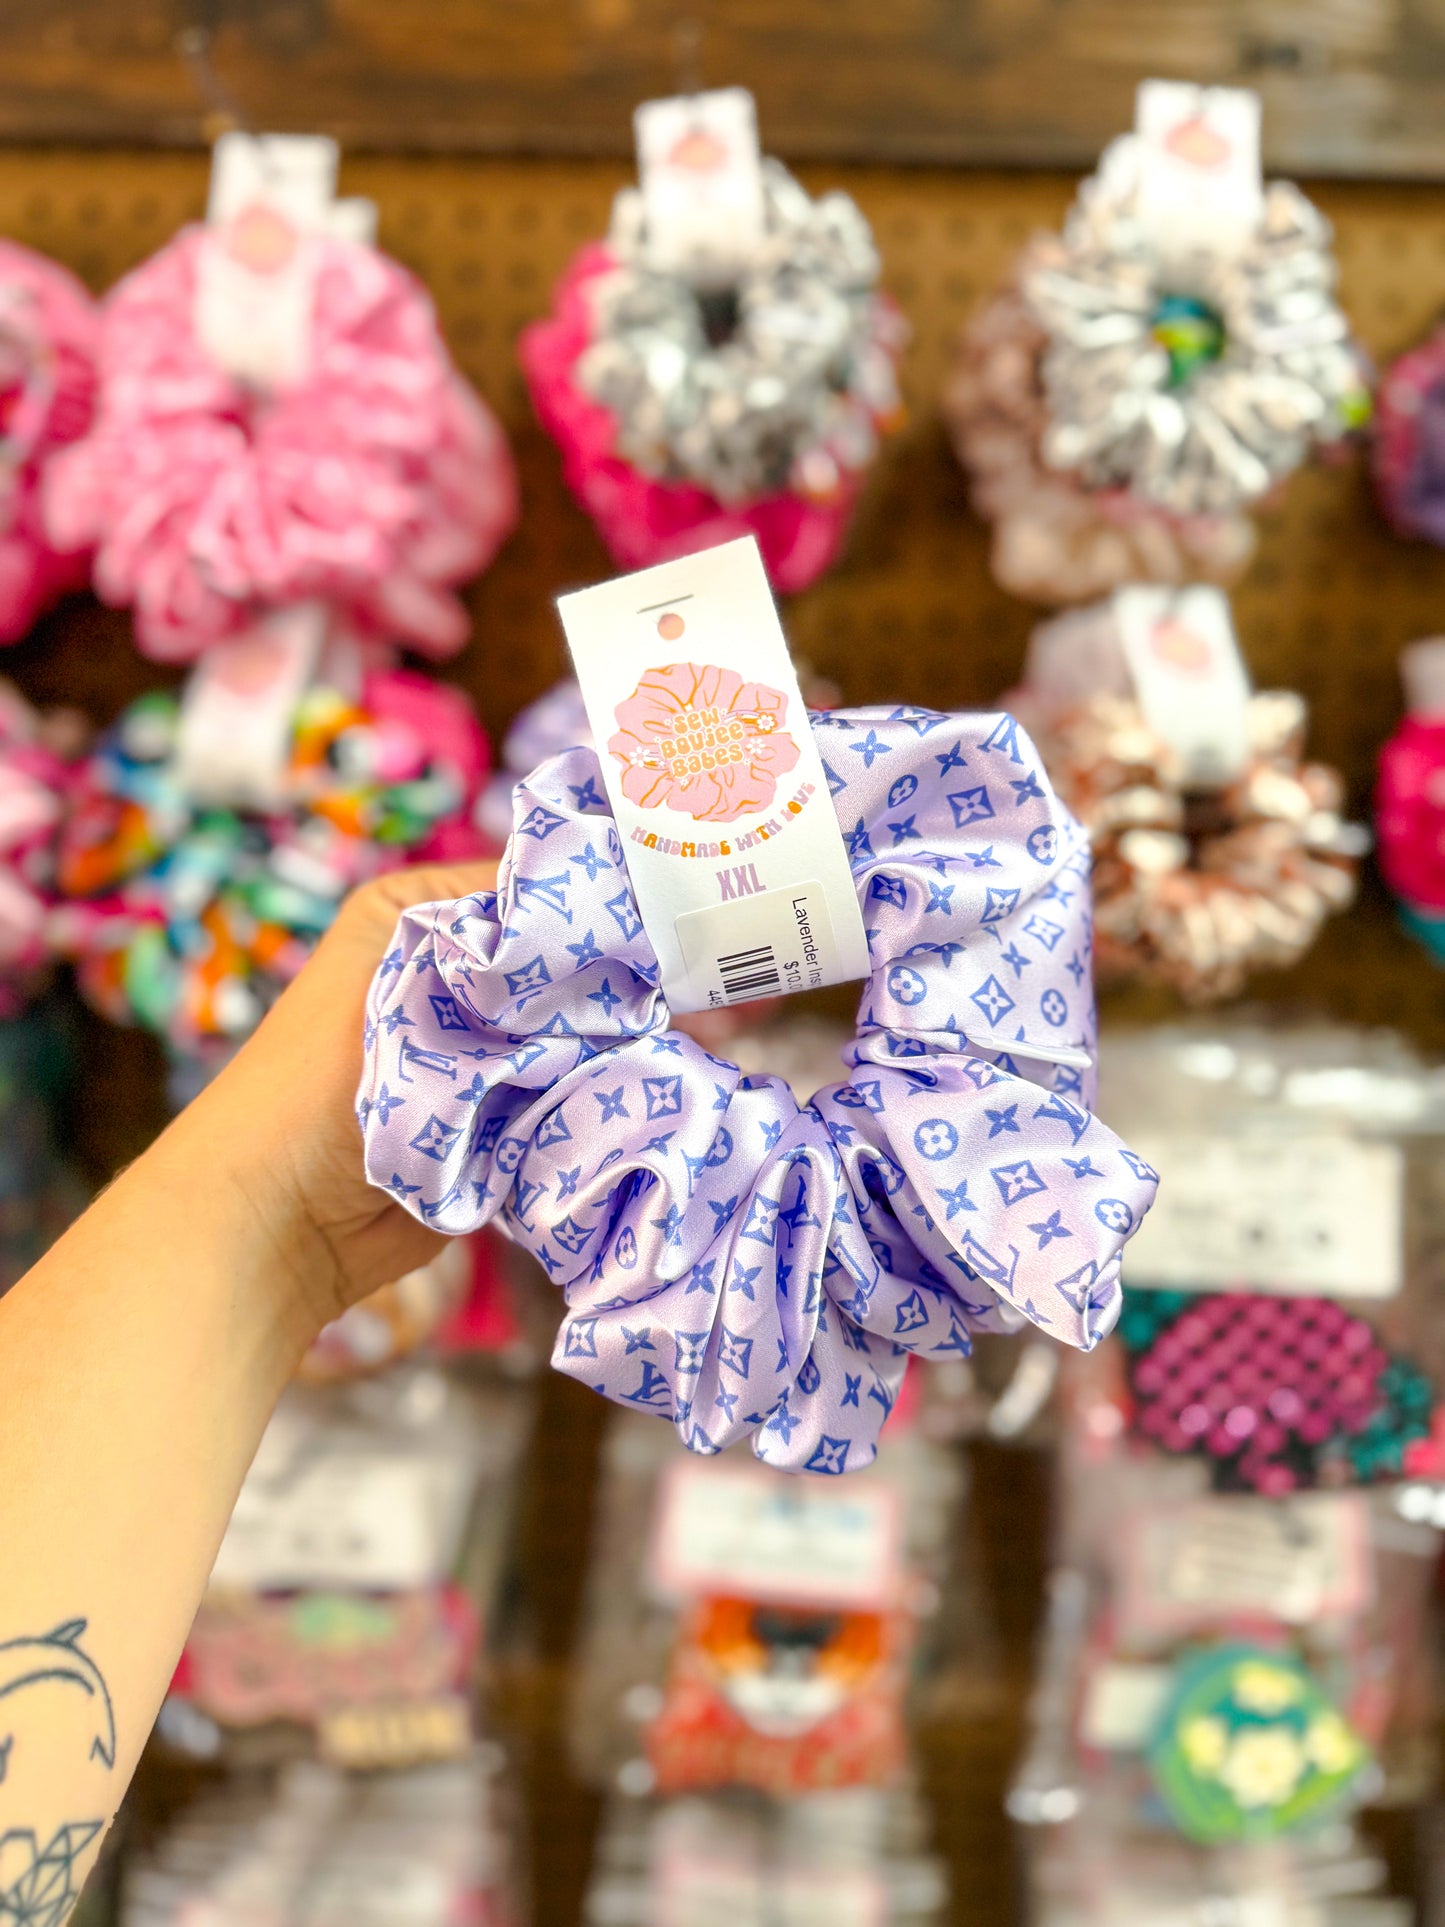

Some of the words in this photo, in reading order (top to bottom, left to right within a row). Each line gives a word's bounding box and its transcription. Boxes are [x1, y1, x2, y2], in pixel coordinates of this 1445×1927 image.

[630, 825, 731, 858] HANDMADE
[735, 818, 782, 851] WITH
[780, 782, 816, 822] LOVE
[715, 862, 767, 901] XXL
[792, 896, 819, 966] Lavender
[808, 967, 823, 986] Ins
